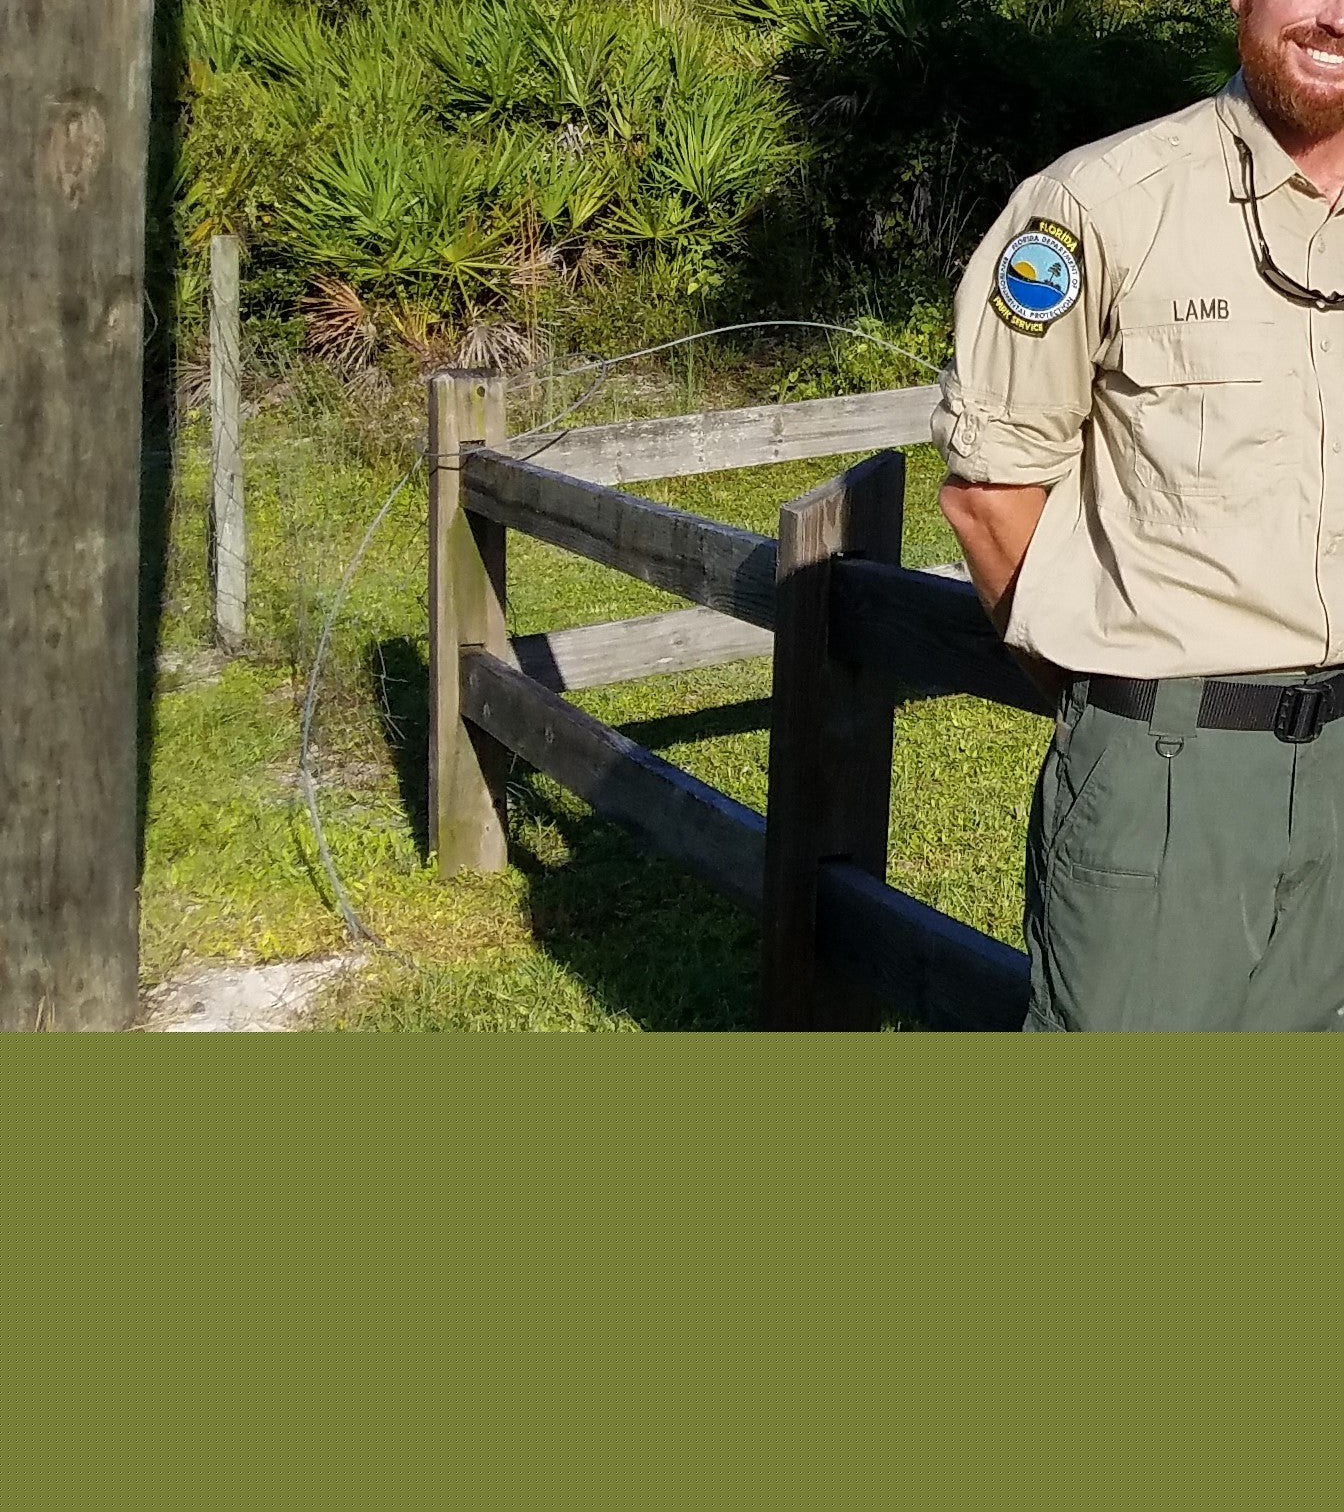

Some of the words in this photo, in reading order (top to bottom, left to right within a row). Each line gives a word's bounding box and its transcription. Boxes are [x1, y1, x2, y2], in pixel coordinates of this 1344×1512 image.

[1039, 221, 1078, 253] FLORIDA
[993, 296, 1011, 320] PARK
[1010, 315, 1043, 332] SERVICE
[1173, 298, 1229, 322] LAMB
